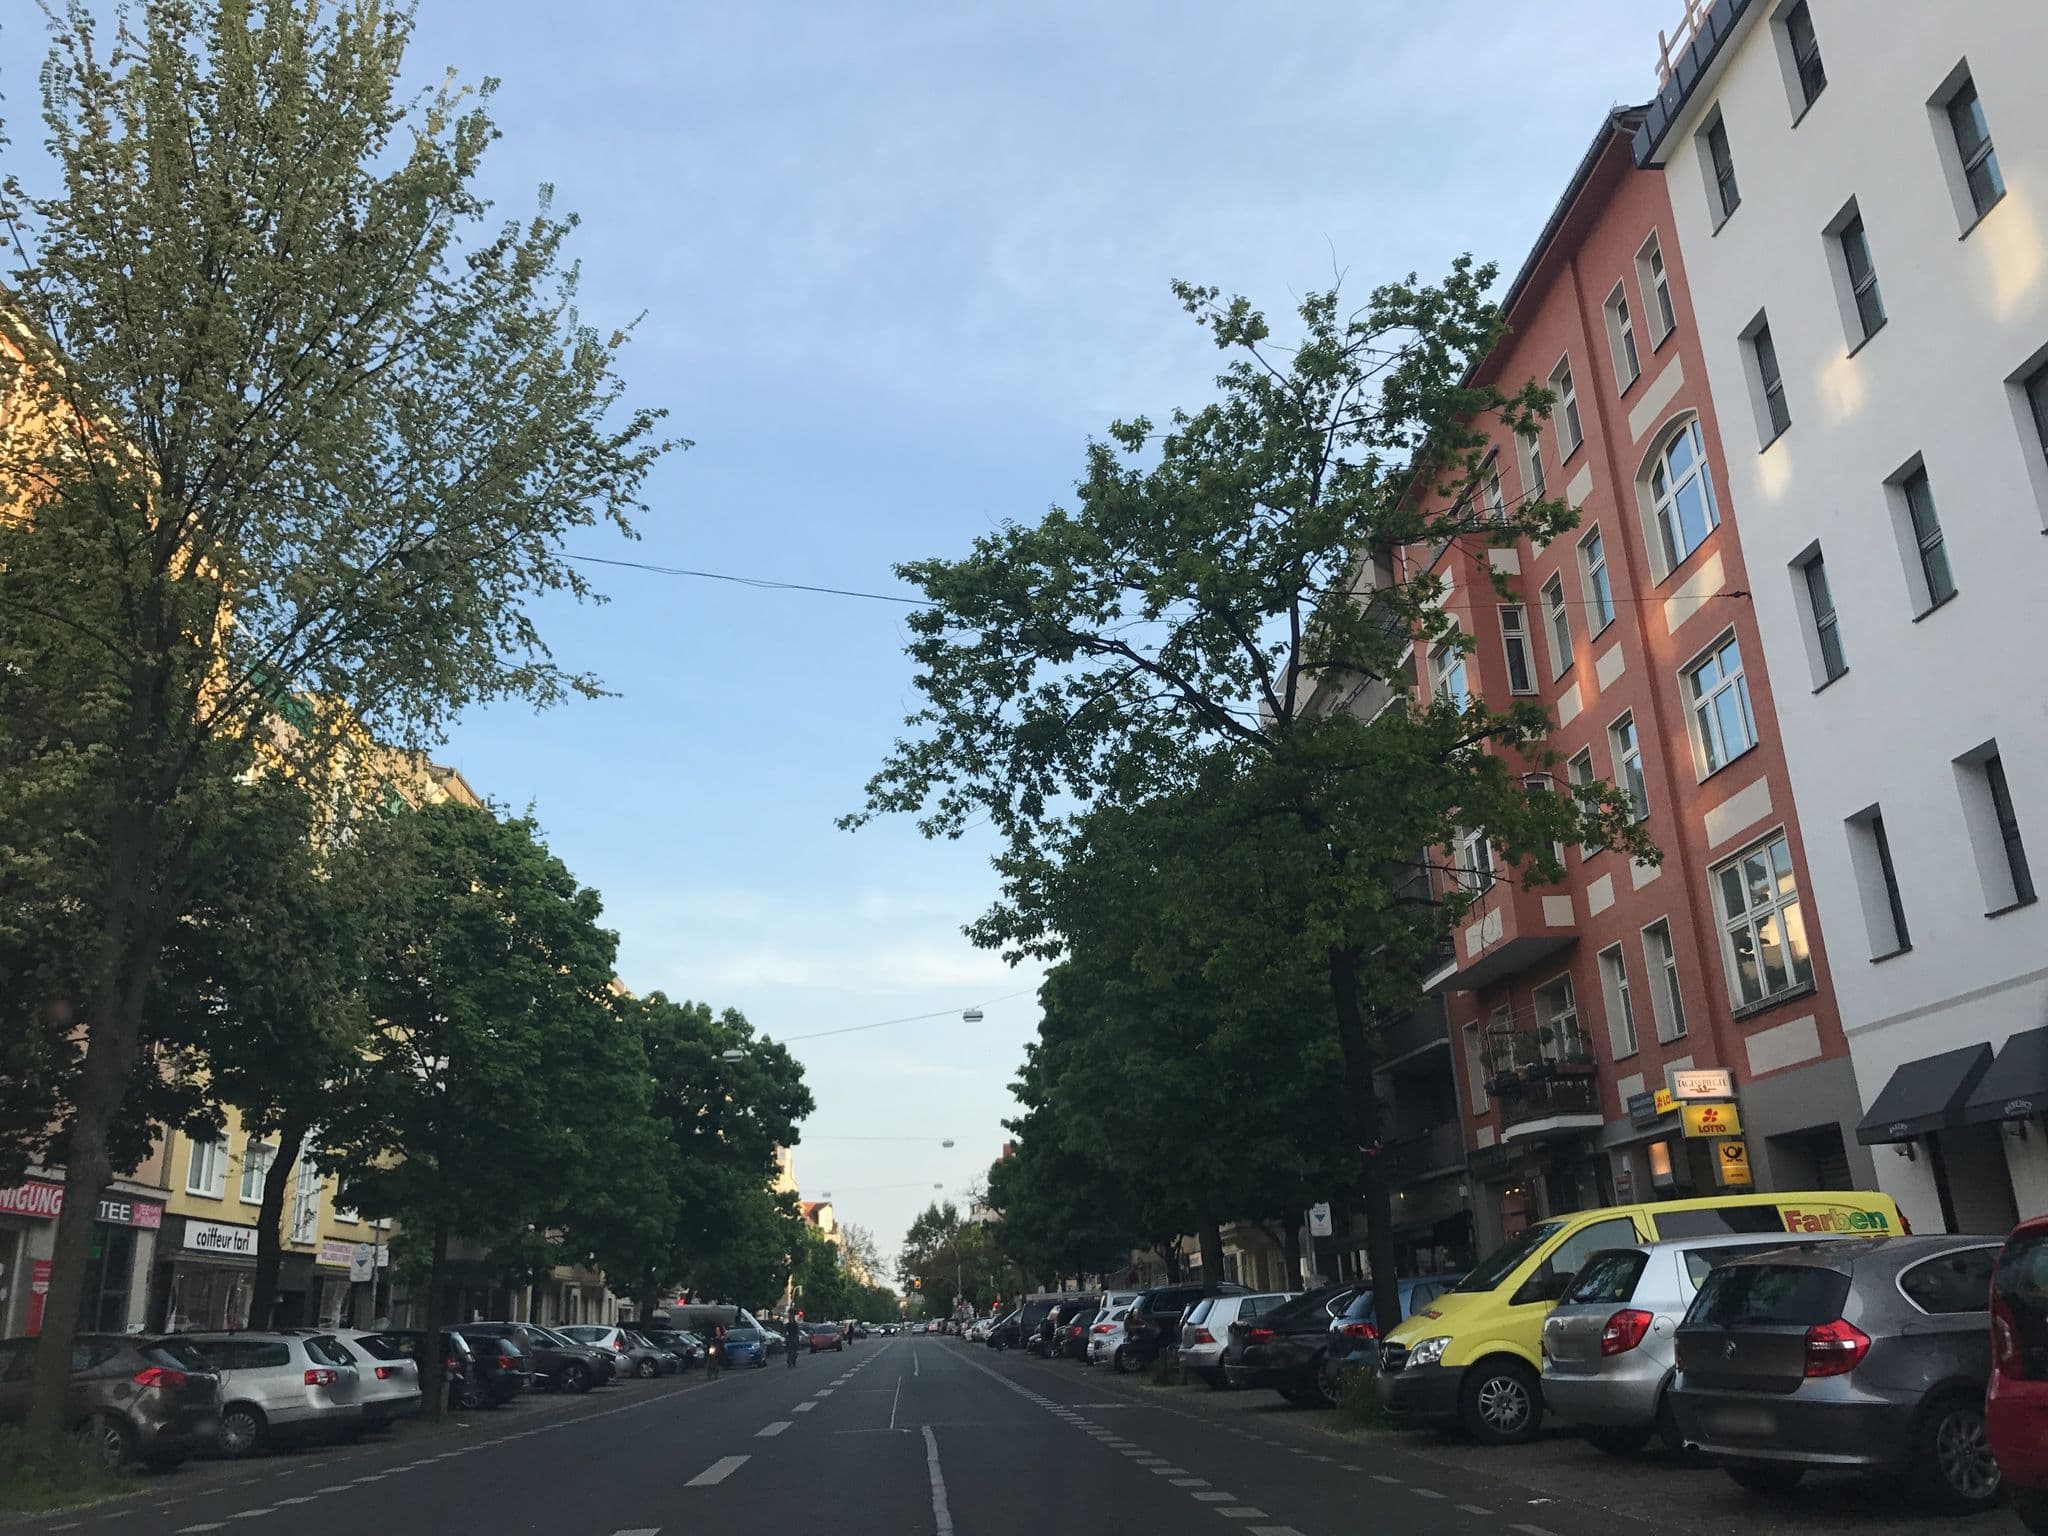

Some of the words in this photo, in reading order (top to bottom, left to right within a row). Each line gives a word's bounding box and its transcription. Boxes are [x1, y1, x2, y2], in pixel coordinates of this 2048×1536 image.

[1698, 1125, 1726, 1133] LOTTO
[100, 1200, 131, 1221] TEE
[1784, 1208, 1888, 1233] Farben
[196, 1227, 232, 1249] coiffeur
